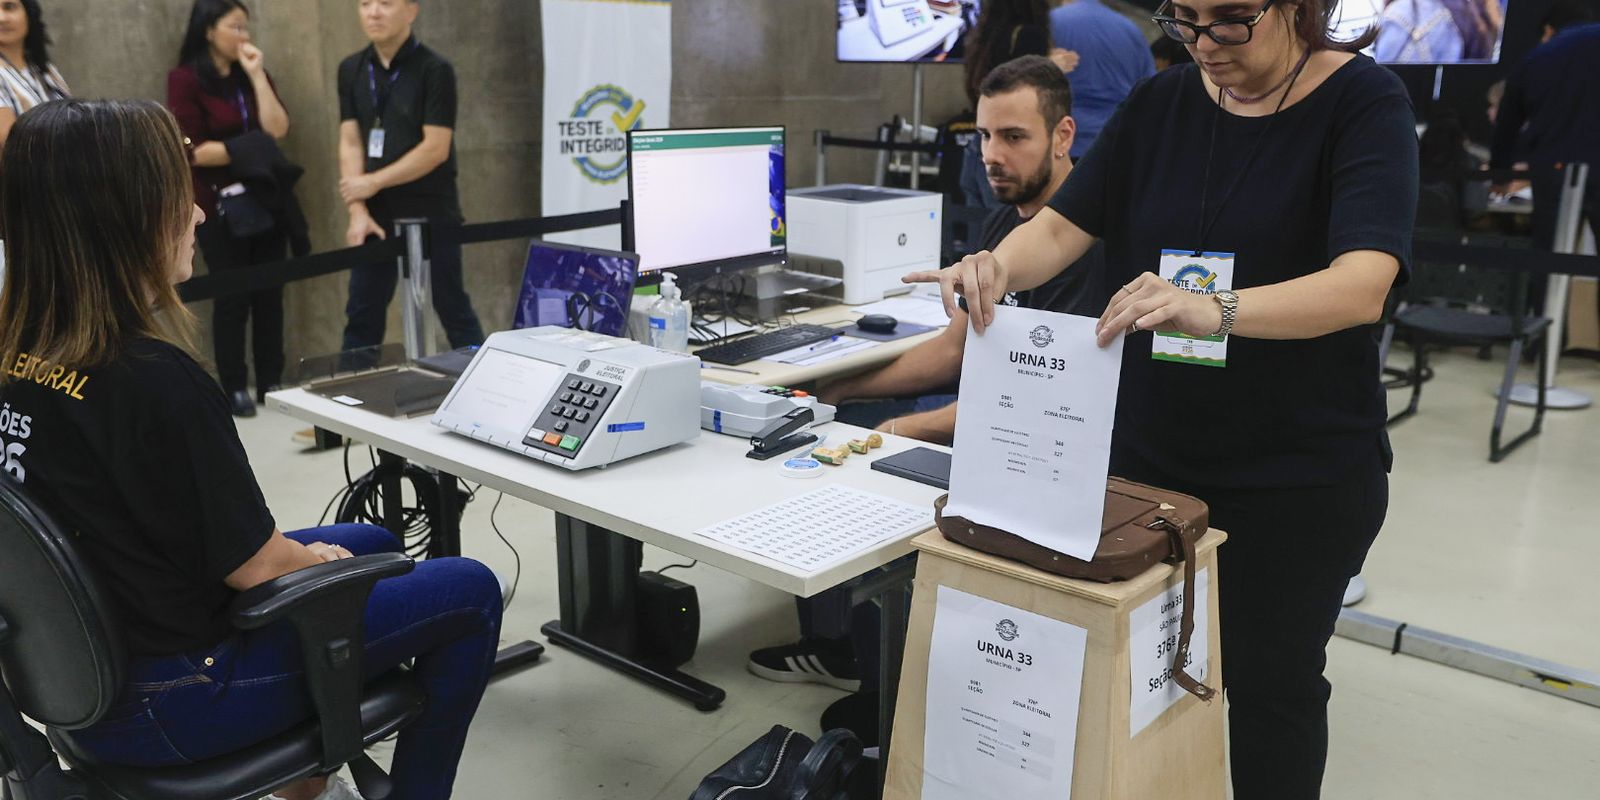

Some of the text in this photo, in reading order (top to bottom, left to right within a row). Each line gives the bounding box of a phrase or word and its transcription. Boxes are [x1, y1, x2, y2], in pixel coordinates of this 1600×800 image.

[558, 121, 603, 136] TESTE
[1009, 350, 1066, 371] URNA 33
[7, 353, 88, 400] EITORAL
[1160, 594, 1182, 614] Urna 33
[977, 640, 1033, 666] URNA 33
[1156, 633, 1176, 659] 376ª
[1148, 668, 1173, 692] Seção
